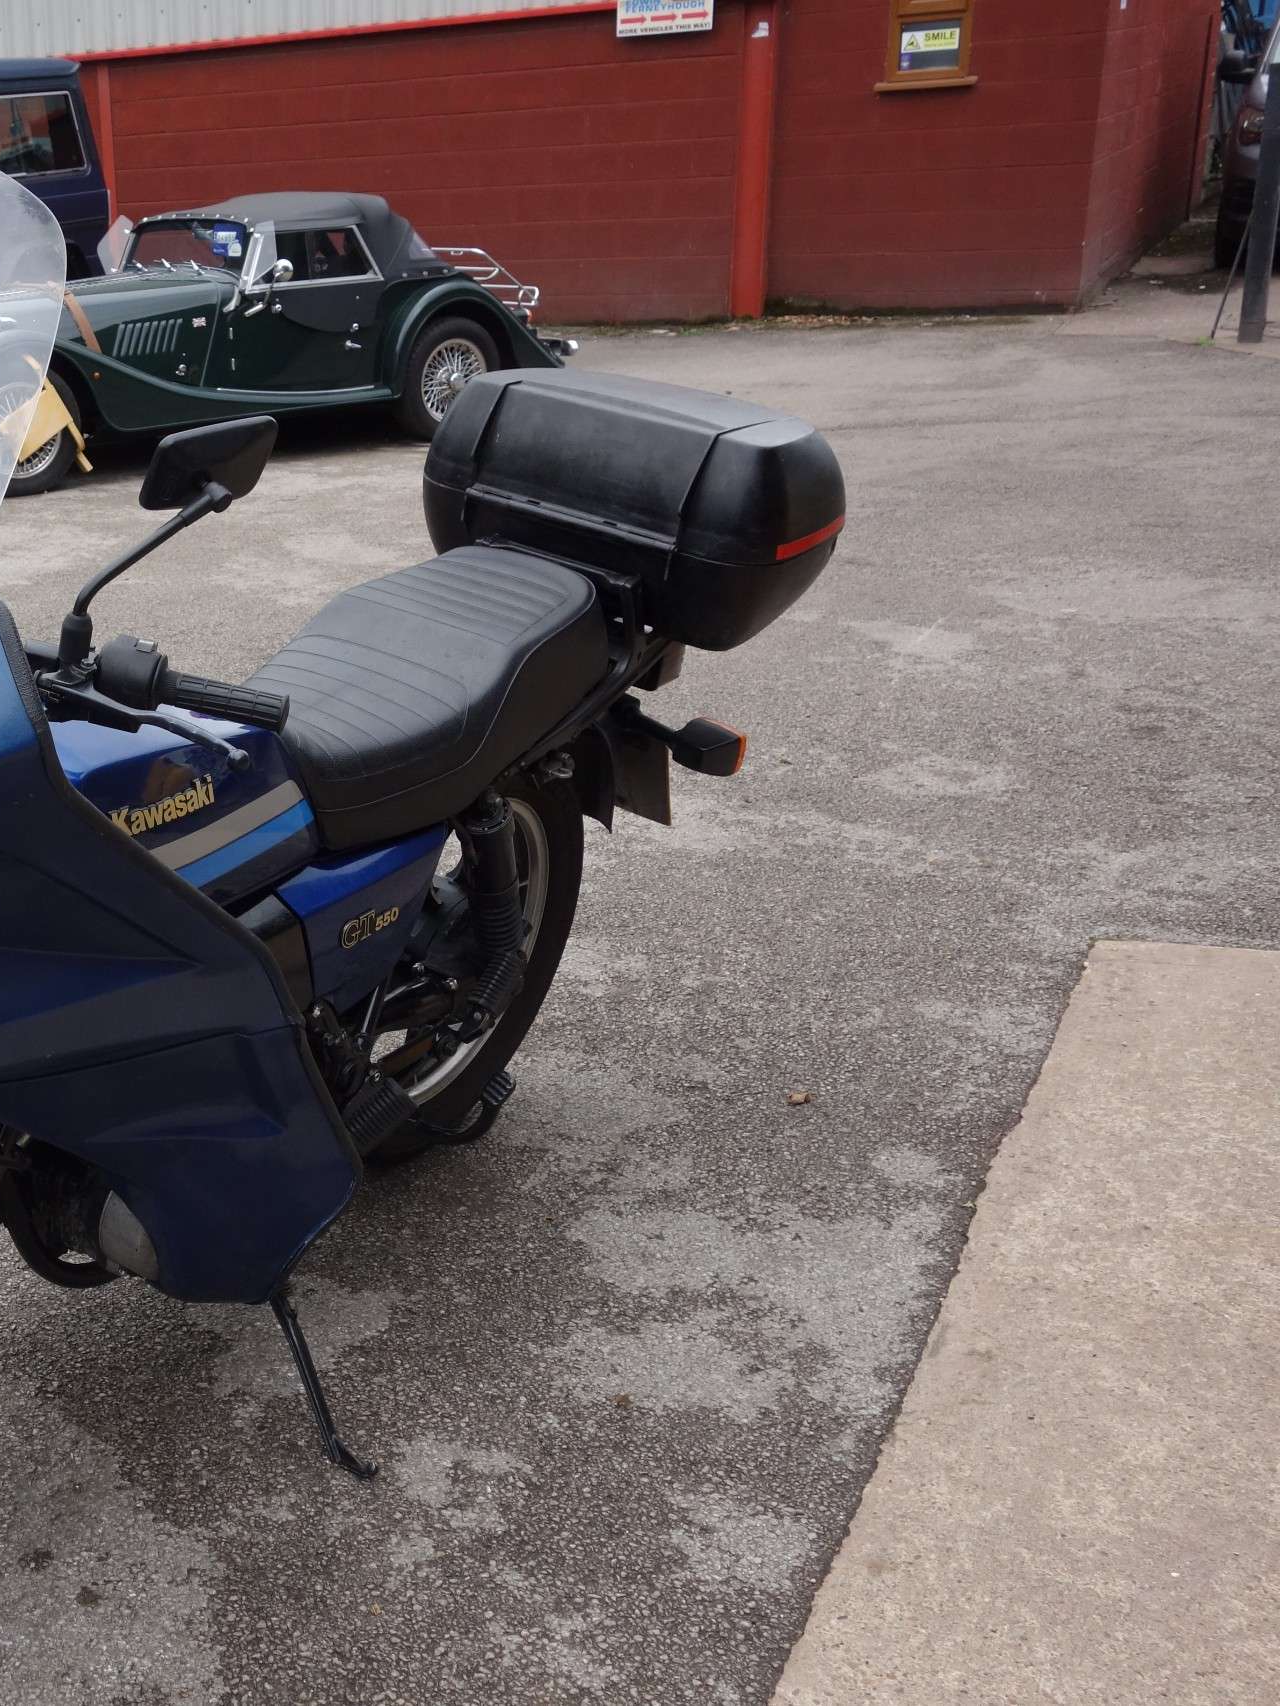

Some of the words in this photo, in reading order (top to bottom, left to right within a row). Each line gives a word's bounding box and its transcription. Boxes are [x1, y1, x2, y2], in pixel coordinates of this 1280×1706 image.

[924, 30, 957, 41] SMILE
[108, 773, 215, 837] Kawasaki
[341, 909, 376, 950] GT
[375, 906, 400, 932] 550
